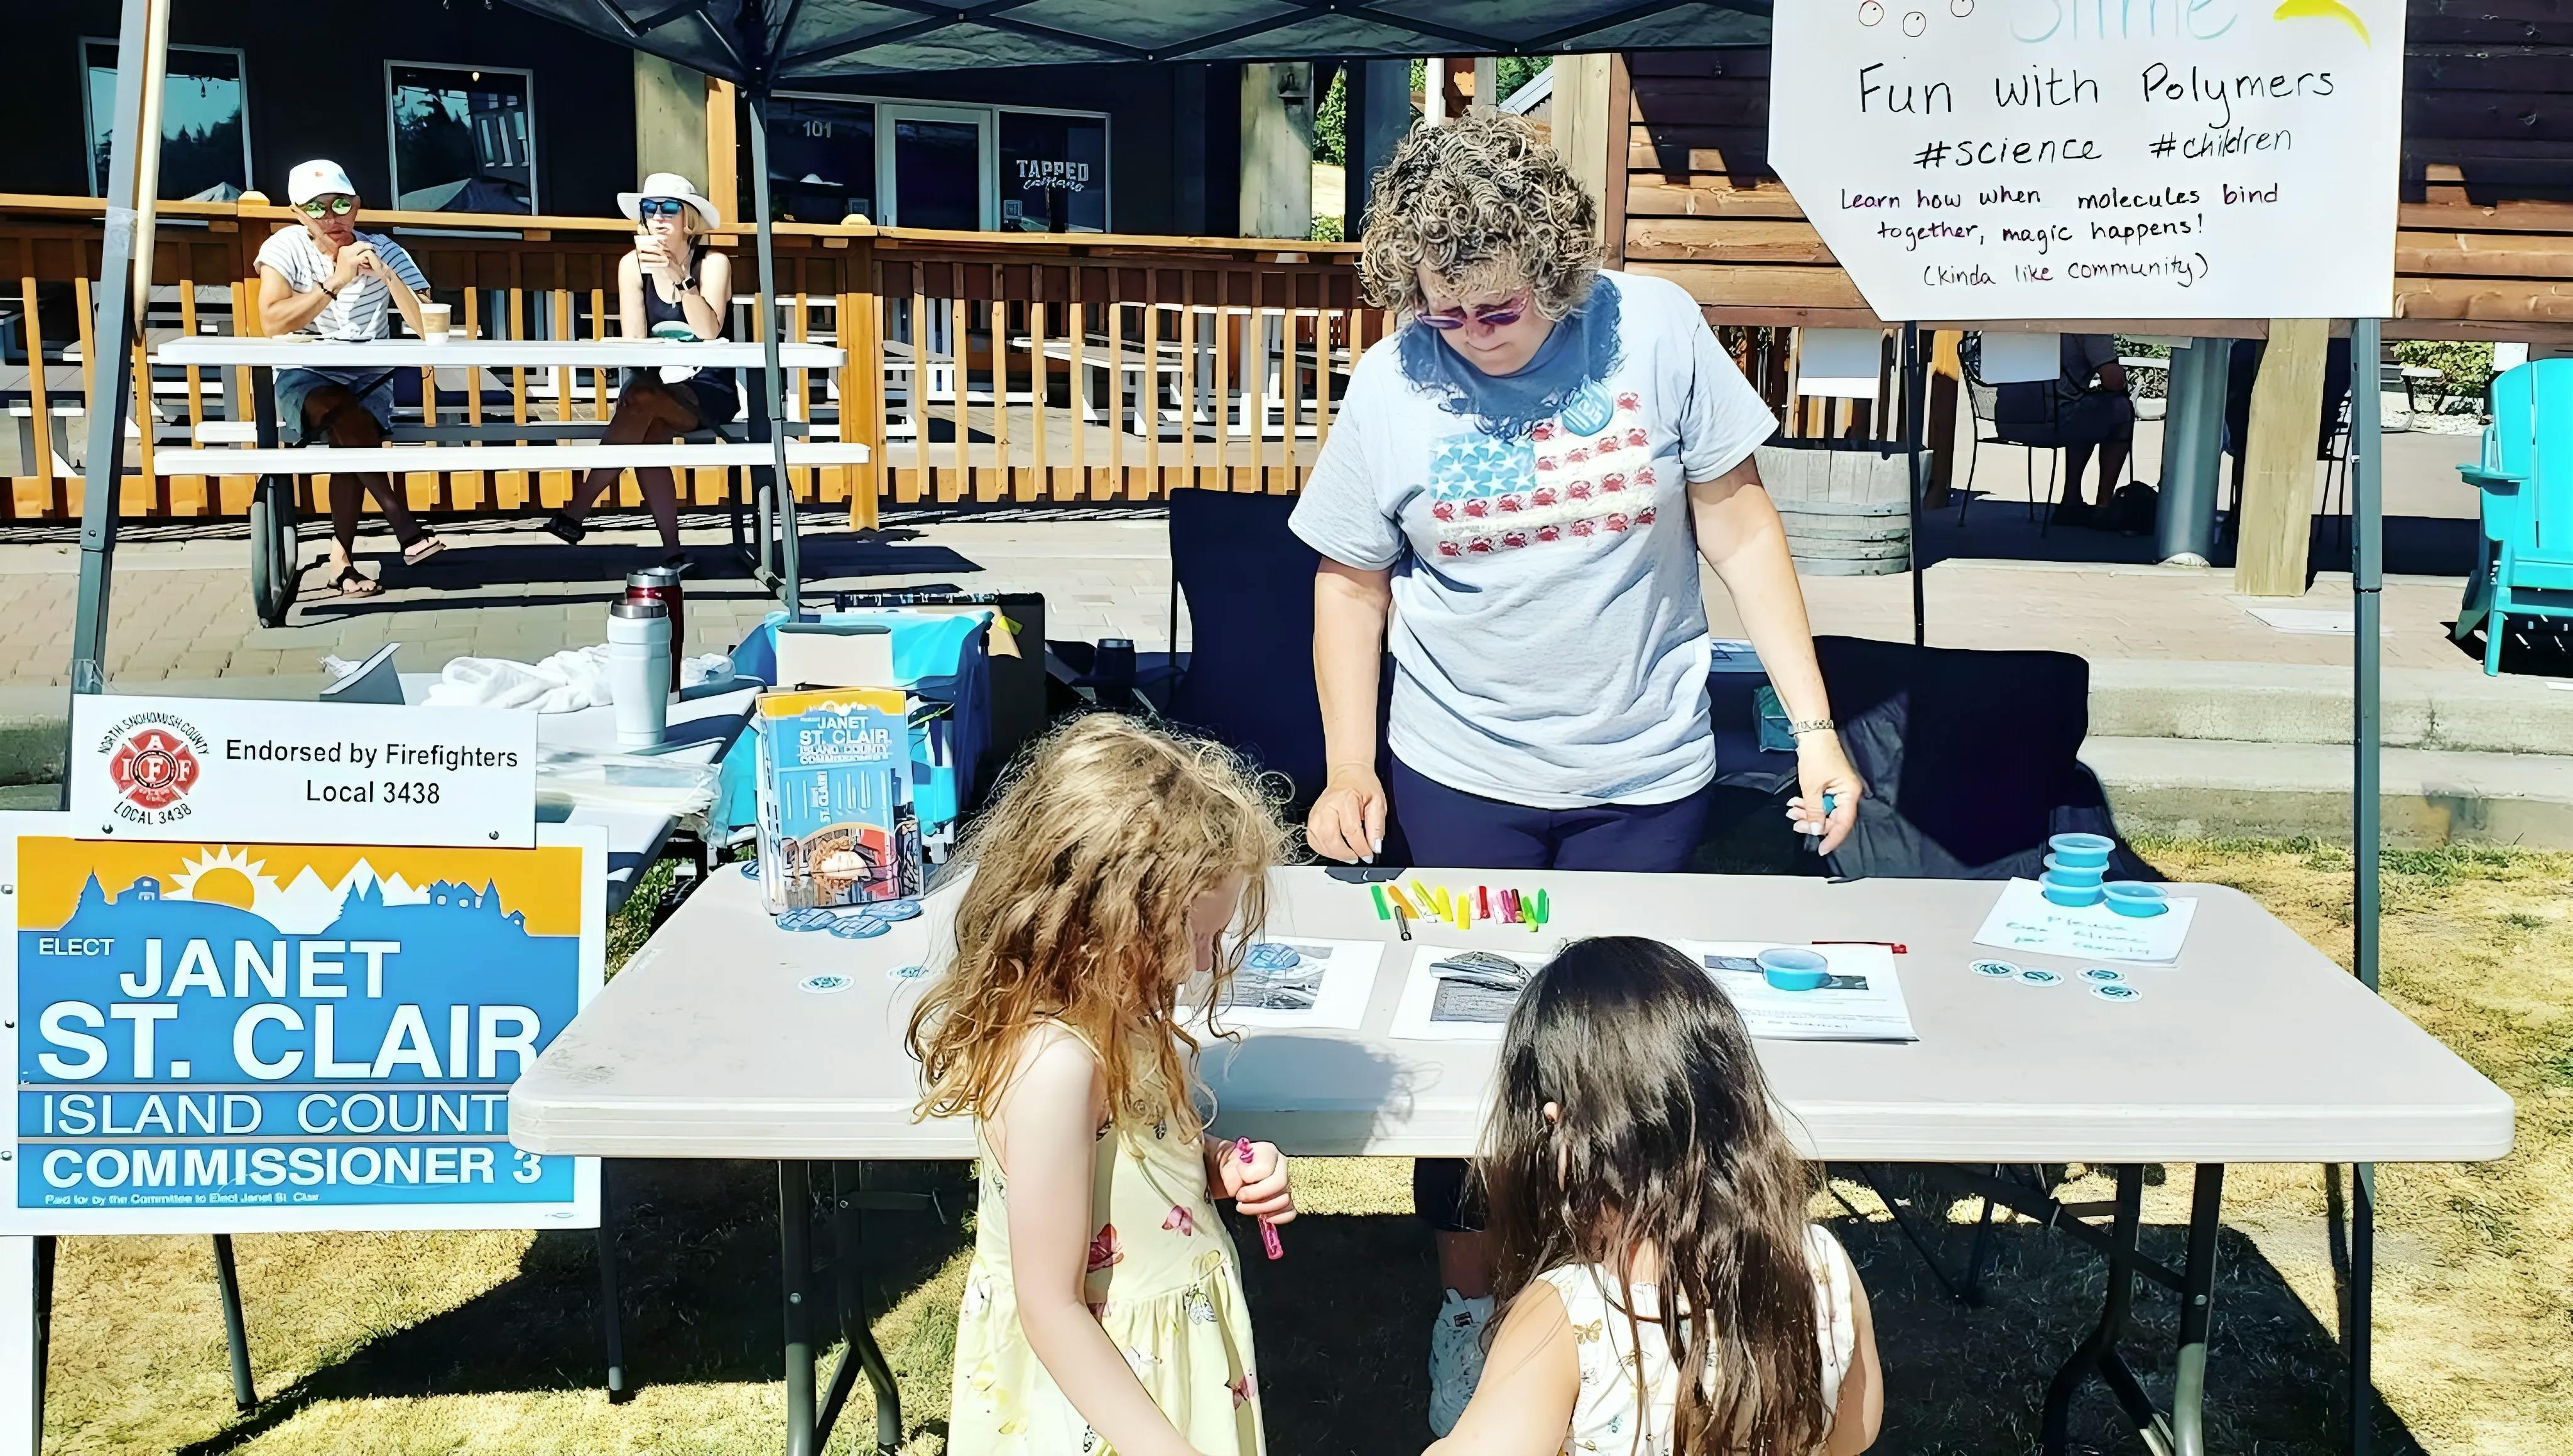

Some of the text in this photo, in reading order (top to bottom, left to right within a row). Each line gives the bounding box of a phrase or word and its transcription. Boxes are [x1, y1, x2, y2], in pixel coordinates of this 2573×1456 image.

[1859, 62, 2334, 129] Fun with Polymers
[802, 120, 832, 138] 101
[1913, 126, 2292, 169] #science #children
[1016, 160, 1089, 182] TAPPED
[1841, 182, 2278, 210] Learn how when molecules bind
[1877, 213, 2203, 255] together, magic happens!
[2015, 264, 2054, 281] like
[2067, 252, 2209, 288] community)
[817, 715, 869, 730] JANET
[226, 739, 518, 771] Endorsed by Firefighters
[306, 780, 440, 804] Local 3438
[113, 801, 192, 825] LOCAL 3438
[39, 937, 401, 999] ELECT JANET
[38, 1000, 541, 1080] ST. CLAIR
[43, 1093, 508, 1135] ISLAND COUNT
[42, 1147, 542, 1187] COMMISSIONER 3
